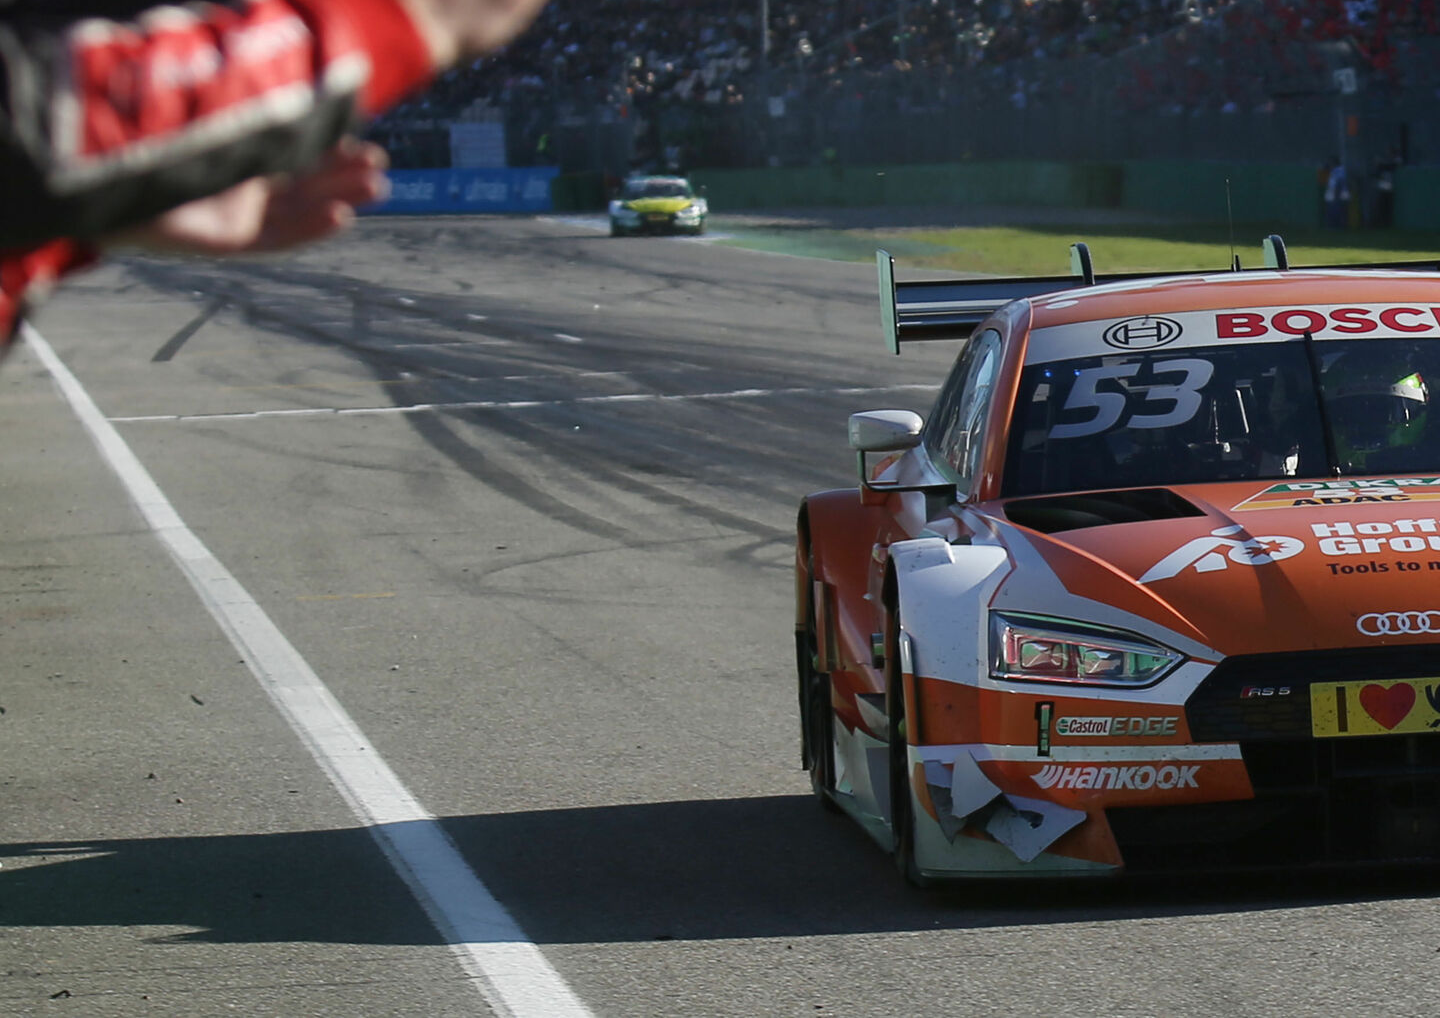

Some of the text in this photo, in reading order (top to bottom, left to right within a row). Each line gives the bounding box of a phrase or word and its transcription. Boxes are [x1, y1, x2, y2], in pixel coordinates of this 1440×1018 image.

[1048, 358, 1215, 440] 53
[1291, 494, 1411, 506] ADAC
[1327, 560, 1388, 576] Tools
[1396, 559, 1420, 573] to
[1067, 716, 1179, 736] Castrol EDGE
